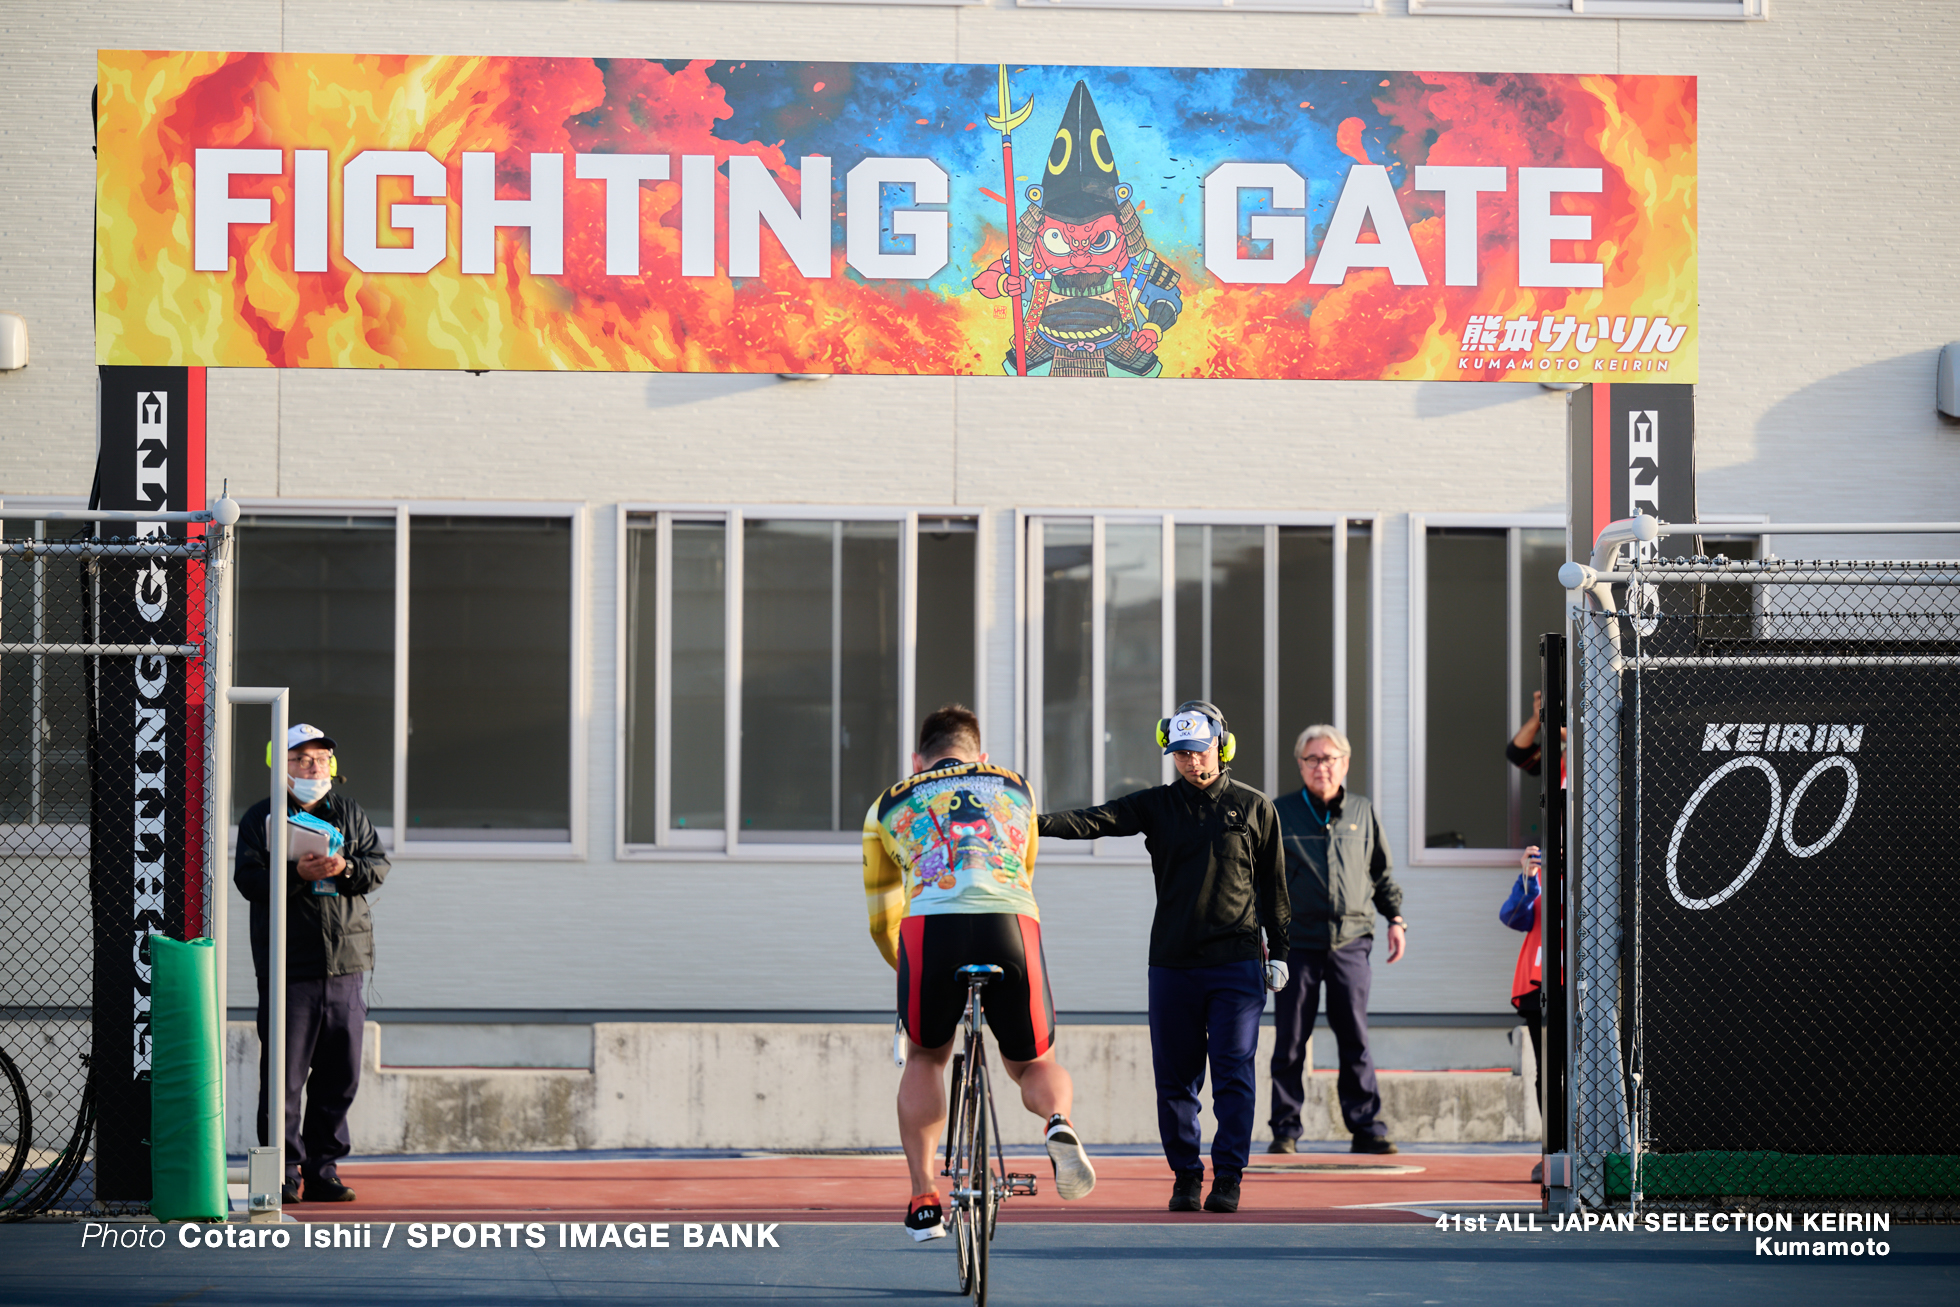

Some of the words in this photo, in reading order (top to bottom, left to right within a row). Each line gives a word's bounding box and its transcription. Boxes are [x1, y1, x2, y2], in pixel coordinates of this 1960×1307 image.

[194, 149, 949, 280] FIGHTING
[1204, 162, 1603, 288] GATE
[1461, 315, 1688, 353] 熊本けいりん
[1458, 358, 1580, 371] KUMAMOTO
[1594, 359, 1669, 371] KEIRIN
[1701, 723, 1865, 753] KEIRIN
